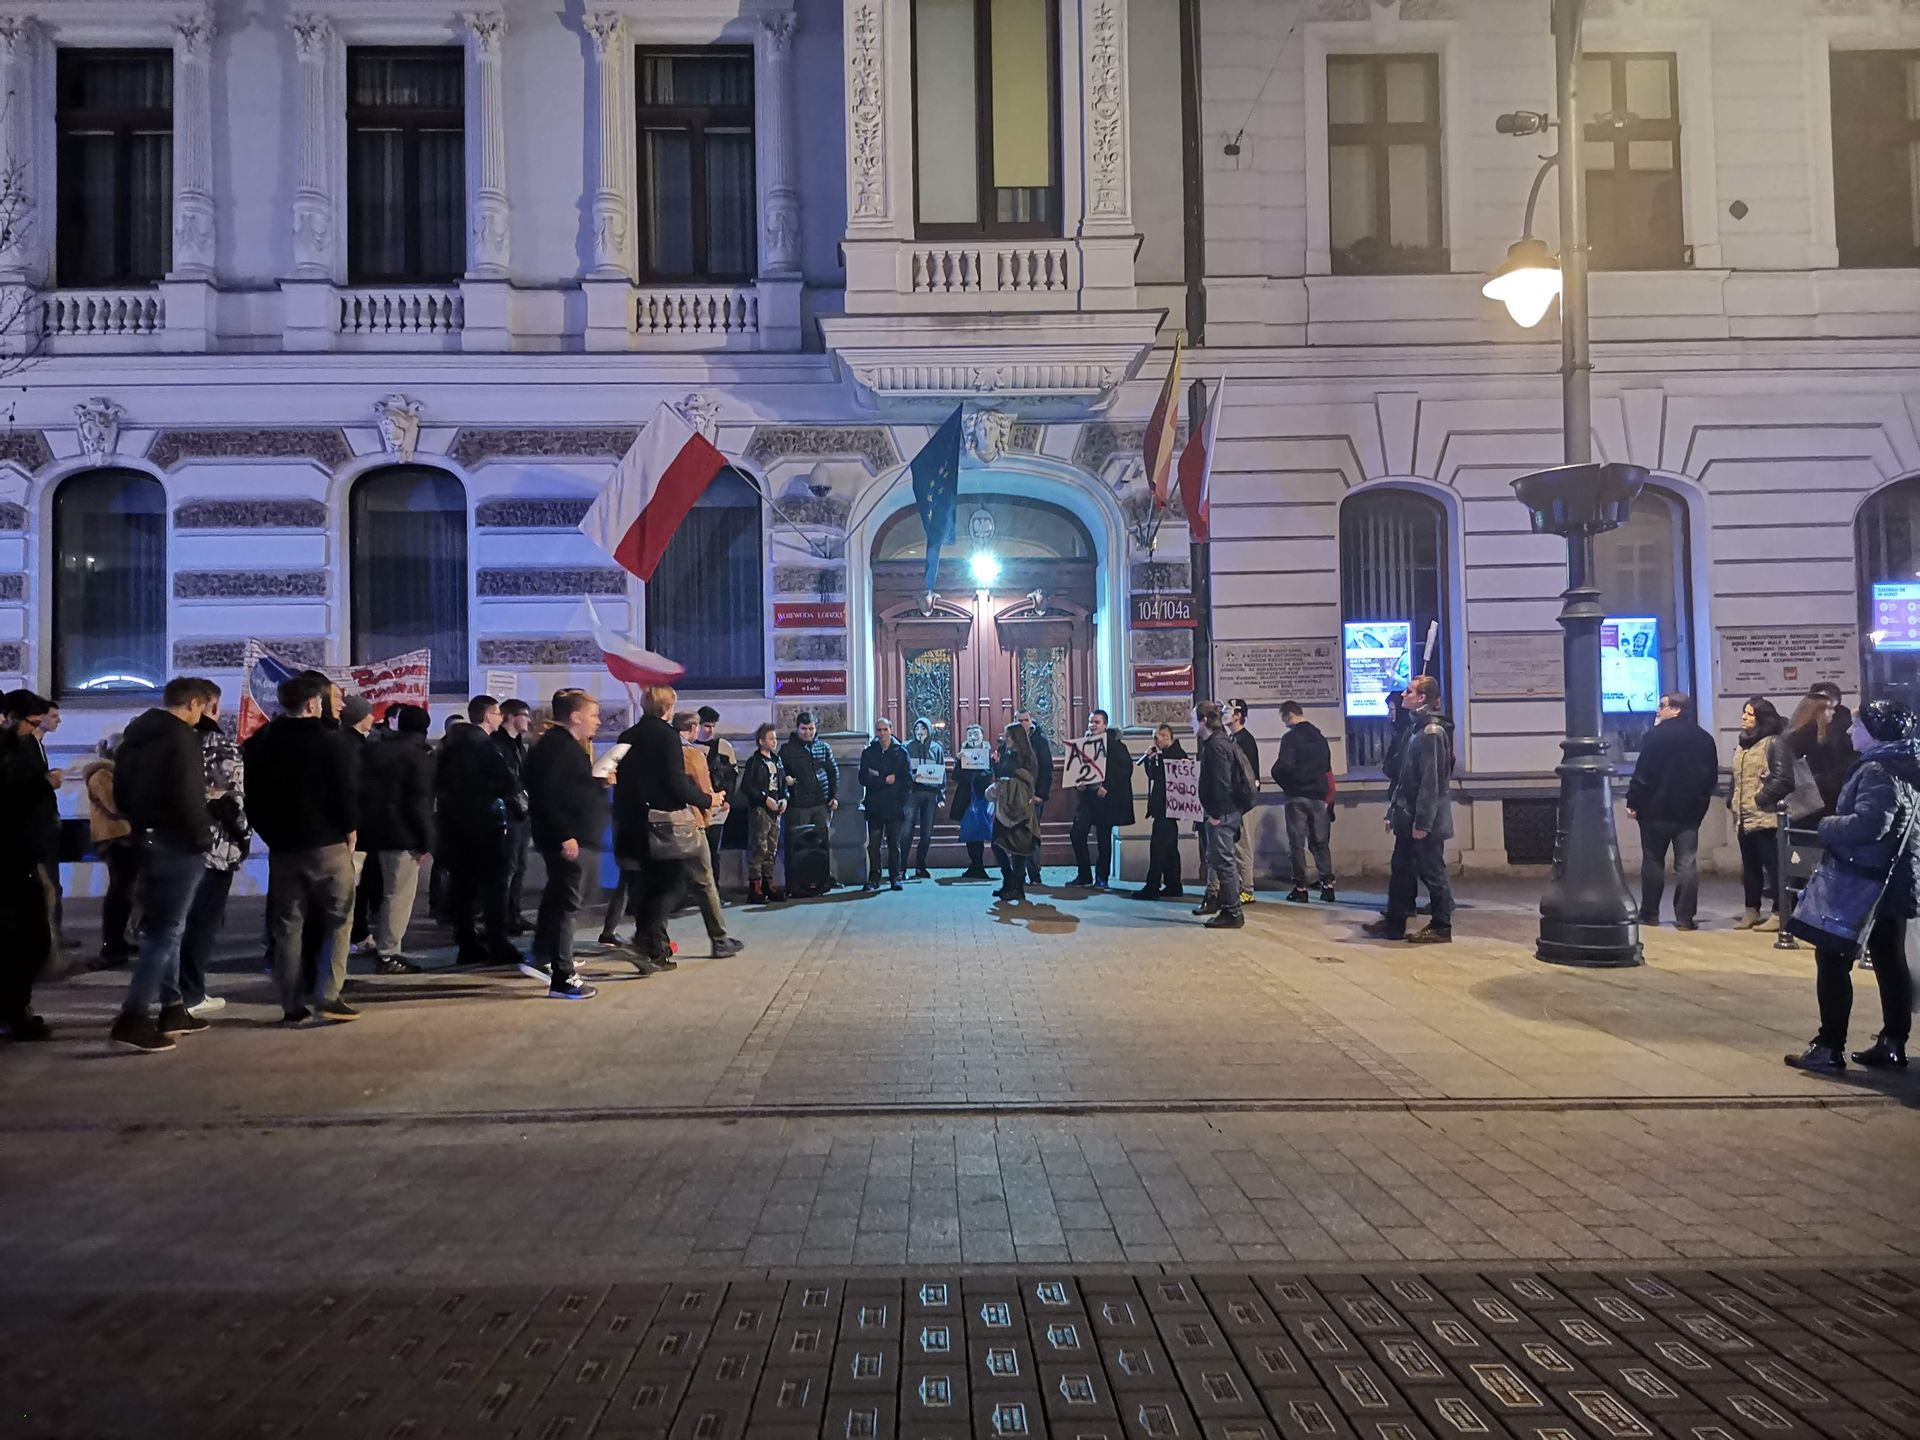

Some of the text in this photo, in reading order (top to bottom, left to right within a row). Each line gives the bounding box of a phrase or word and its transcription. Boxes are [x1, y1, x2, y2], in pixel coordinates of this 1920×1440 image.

[1138, 600, 1190, 621] 104/104a
[1066, 738, 1106, 771] ACTA
[1076, 765, 1097, 783] 2
